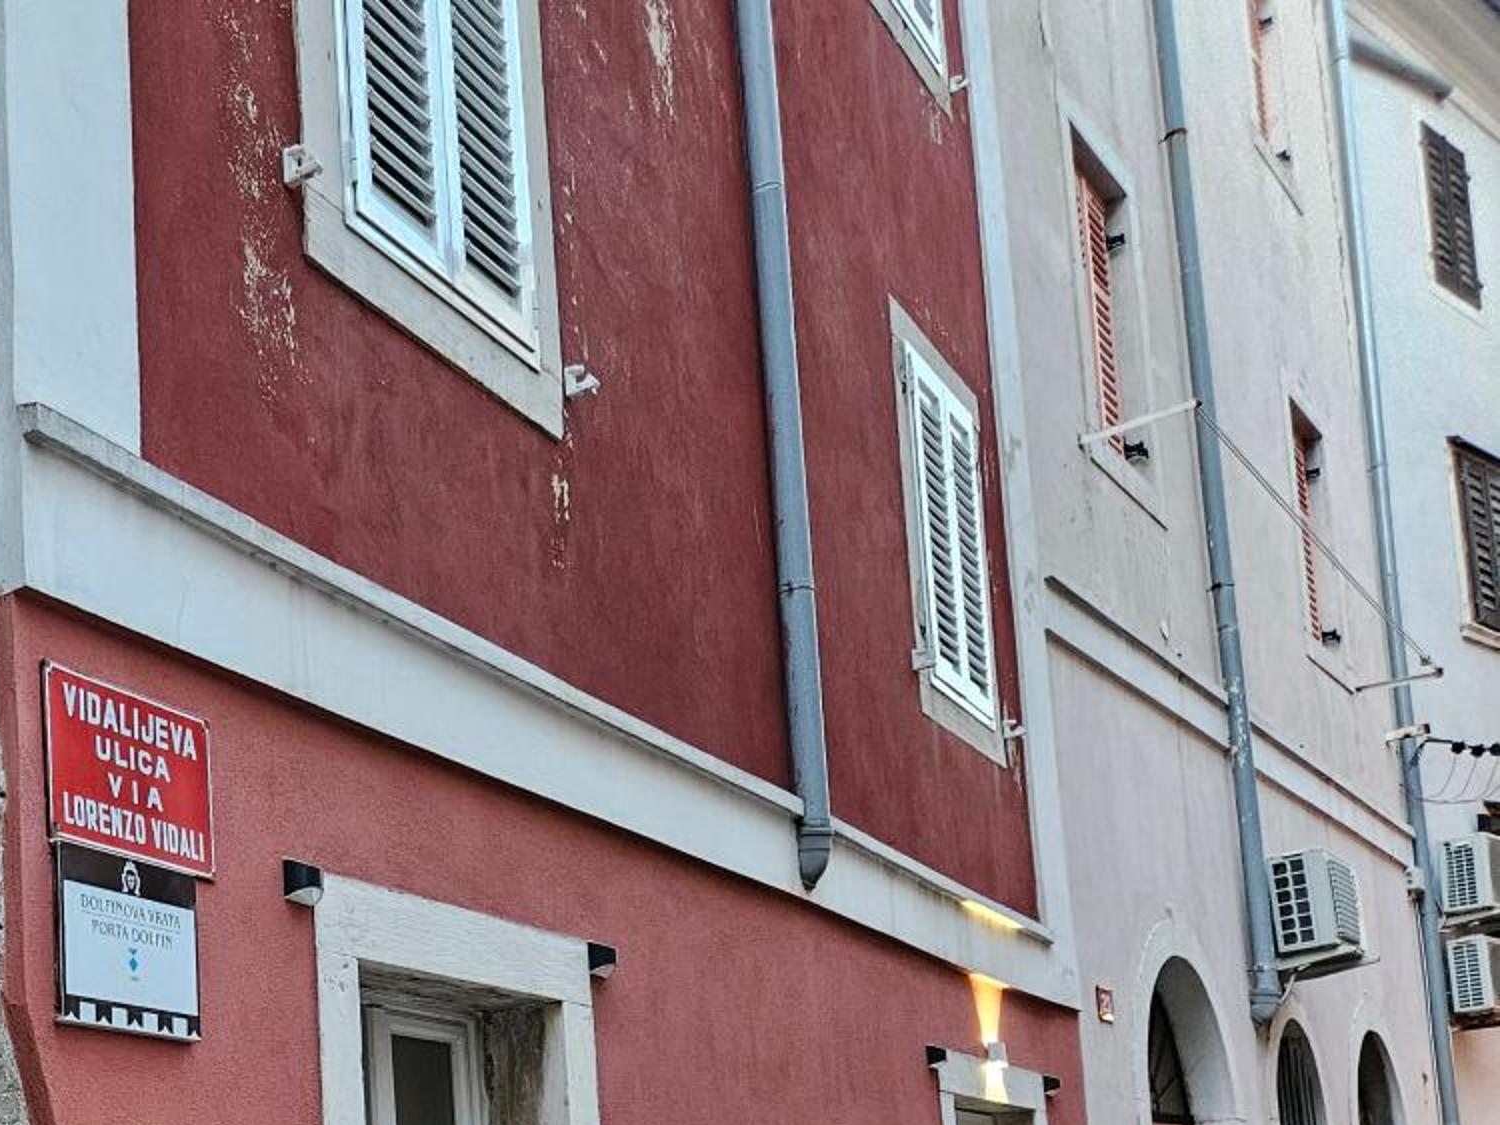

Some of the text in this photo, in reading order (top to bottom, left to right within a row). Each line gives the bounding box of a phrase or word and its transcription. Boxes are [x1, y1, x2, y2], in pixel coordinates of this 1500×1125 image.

[62, 681, 197, 761] VIDALIJEVA
[95, 735, 171, 783] ULICA
[63, 791, 205, 863] LORENZO VIDALI
[80, 893, 146, 922] DOLFINOVA
[91, 918, 173, 949] PORTA DOLFIN
